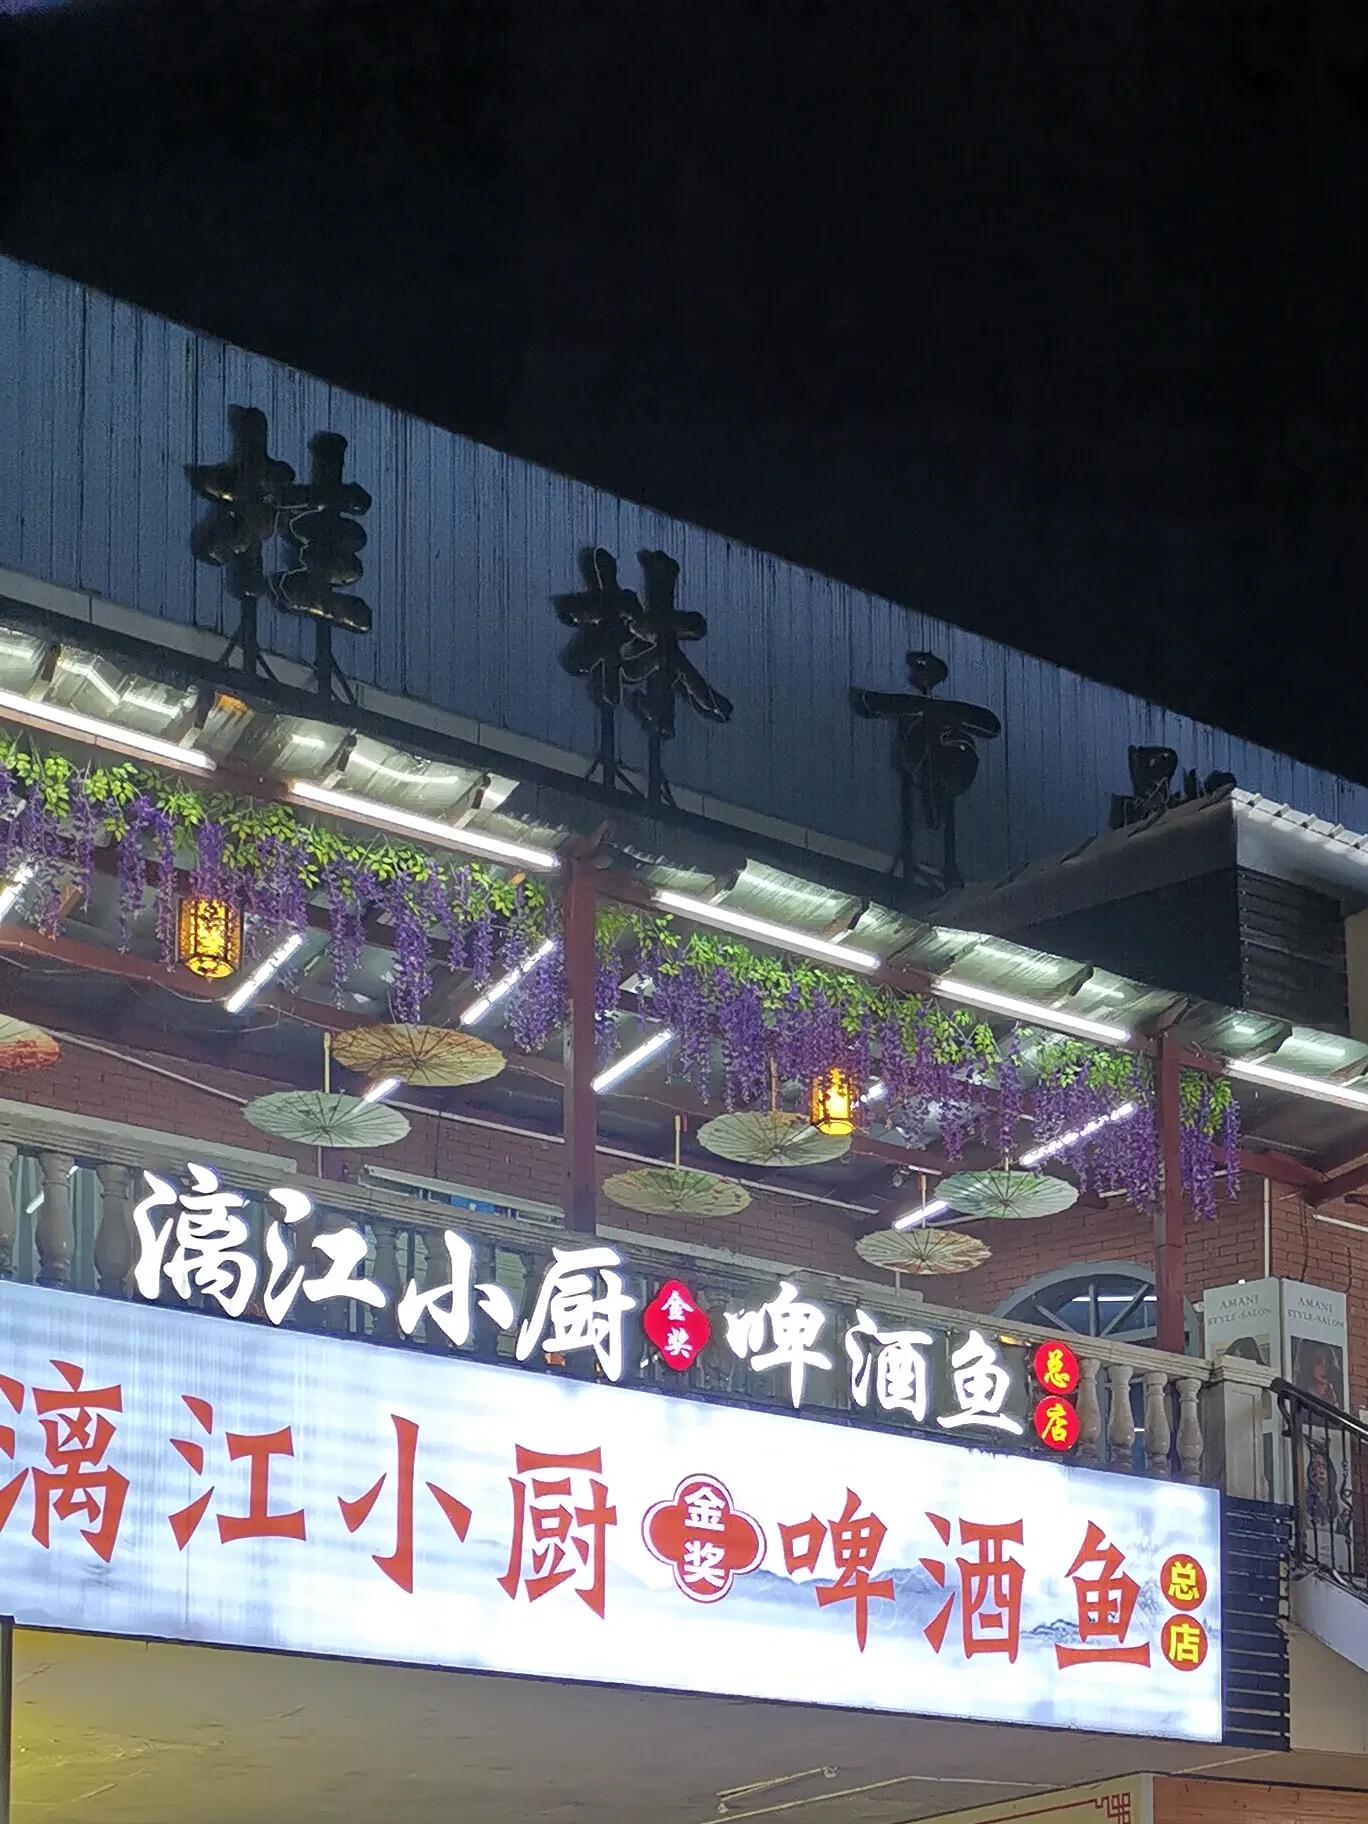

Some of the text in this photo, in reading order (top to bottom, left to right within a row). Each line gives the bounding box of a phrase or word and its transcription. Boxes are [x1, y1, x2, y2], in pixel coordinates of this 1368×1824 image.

[134, 1163, 1073, 1446] 漓江小厨 金奖 啤酒鱼 总店
[1220, 1293, 1259, 1310] AMANI
[1299, 1297, 1333, 1313] AMANI
[1207, 1307, 1272, 1326] STYLE-SALON
[1288, 1308, 1345, 1329] STYLE-SALON
[0, 1361, 1201, 1670] 漓江小厨 金奖 啤酒鱼 总店
